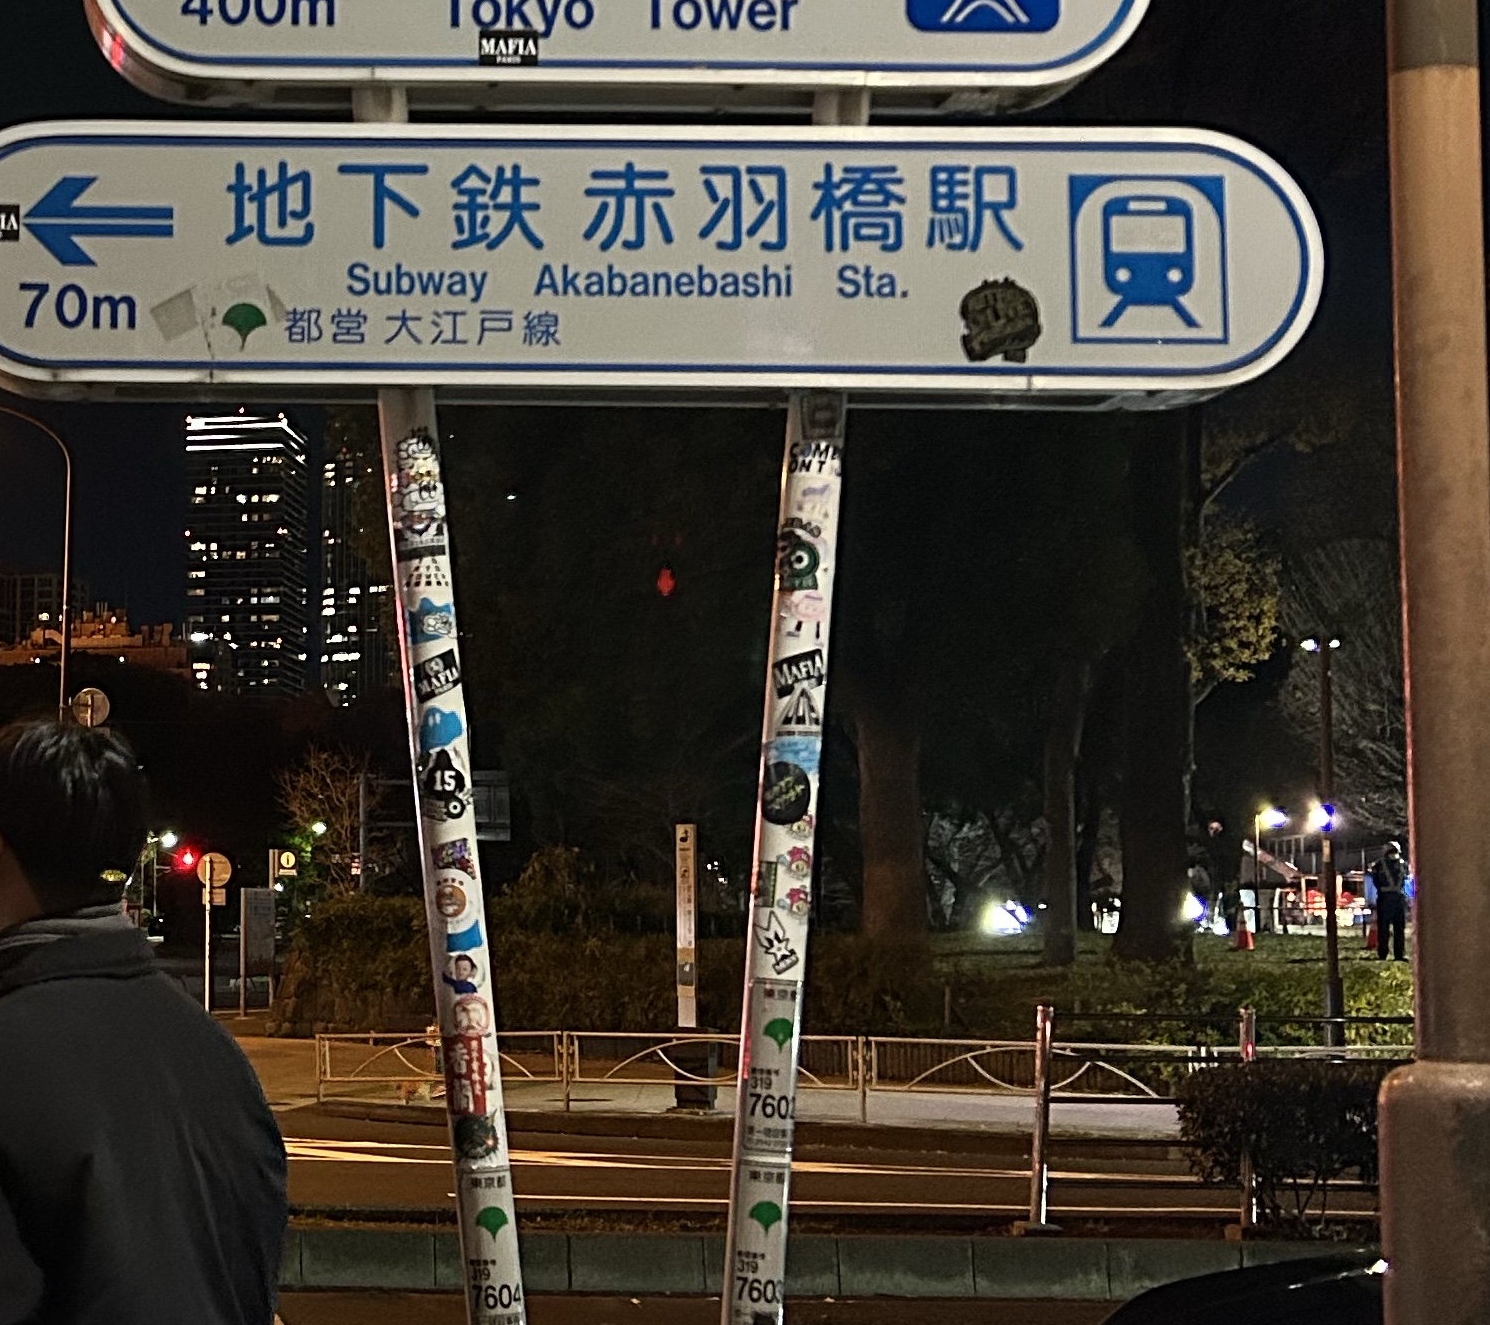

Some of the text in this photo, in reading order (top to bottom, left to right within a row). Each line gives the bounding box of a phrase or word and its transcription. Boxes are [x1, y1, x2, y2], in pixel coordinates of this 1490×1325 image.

[481, 37, 537, 55] MAFIA
[346, 262, 908, 304] Subway Akabanebashi Sta.
[19, 282, 136, 330] 70m
[433, 770, 456, 792] 15
[472, 1284, 521, 1310] 7604
